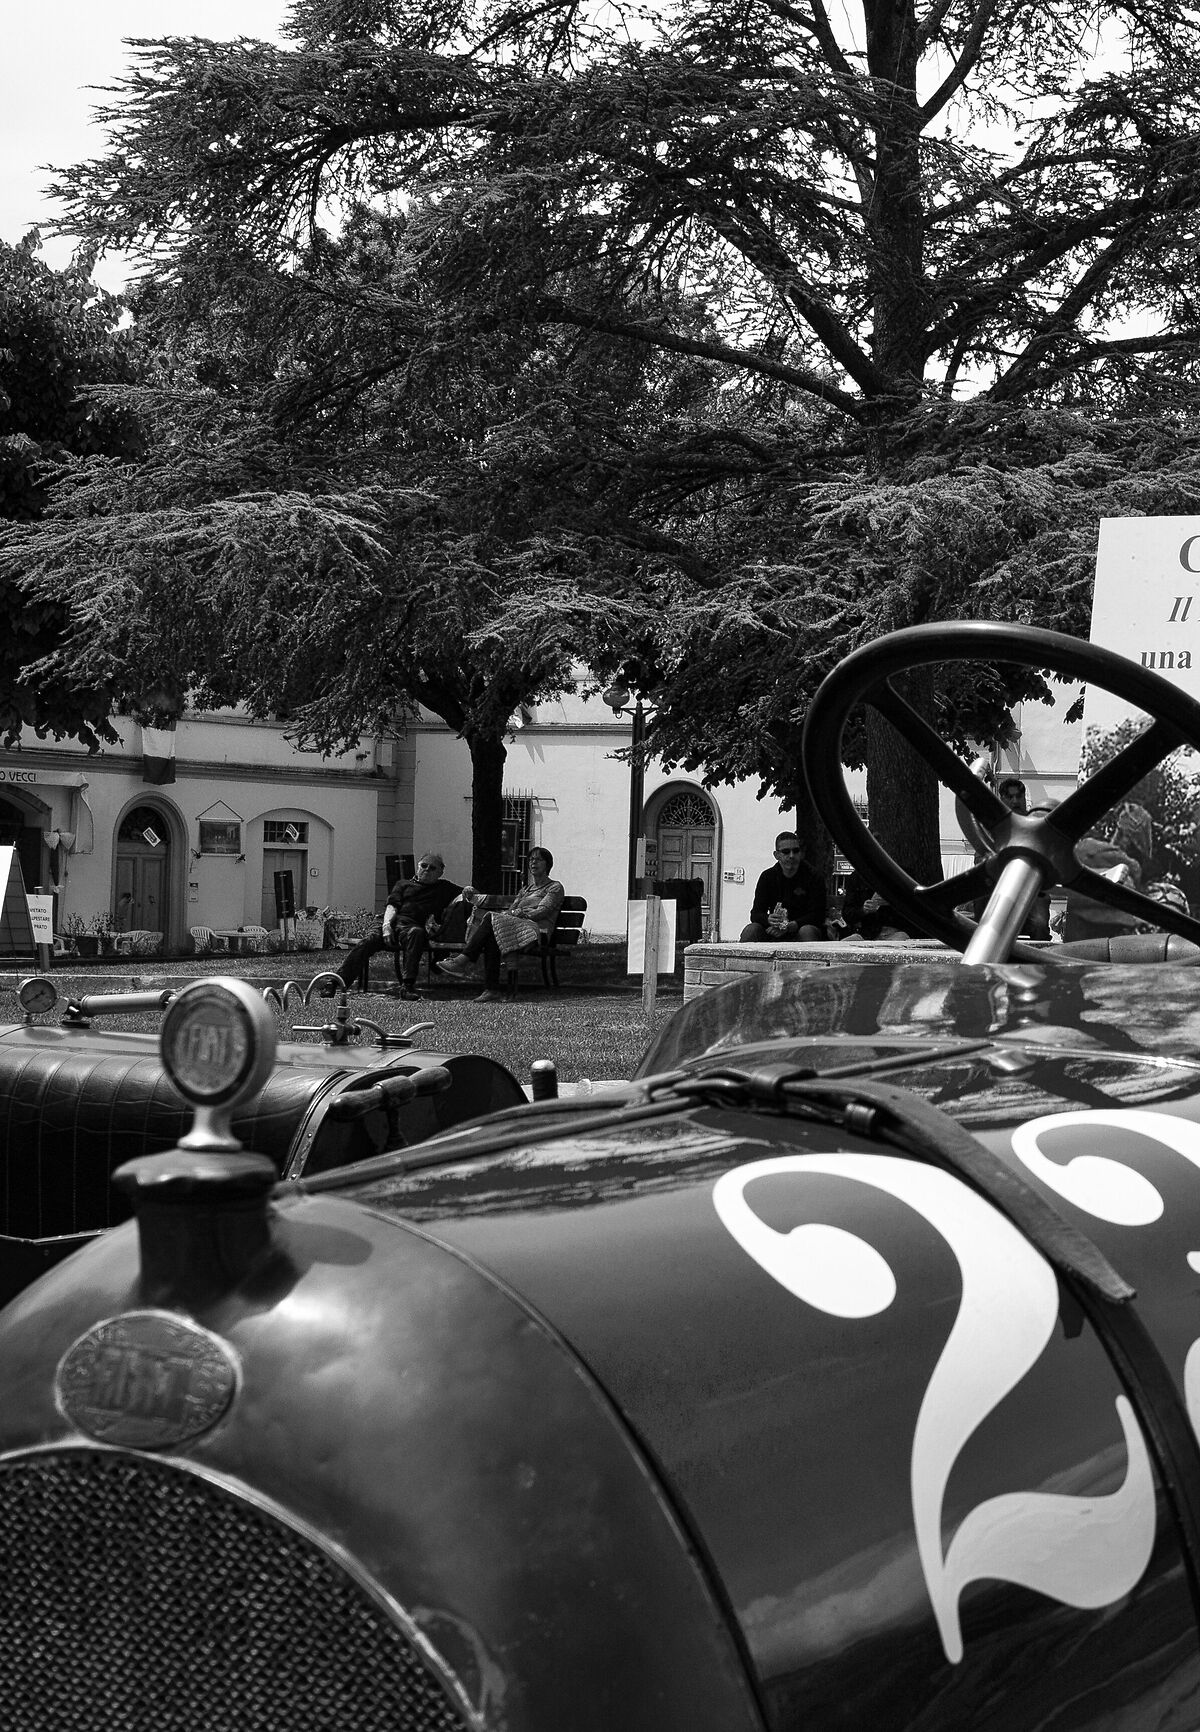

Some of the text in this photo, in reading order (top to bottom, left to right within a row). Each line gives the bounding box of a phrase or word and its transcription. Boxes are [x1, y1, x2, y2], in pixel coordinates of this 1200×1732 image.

[1167, 596, 1193, 623] Il
[1140, 650, 1193, 670] una
[9, 771, 37, 782] VECCI
